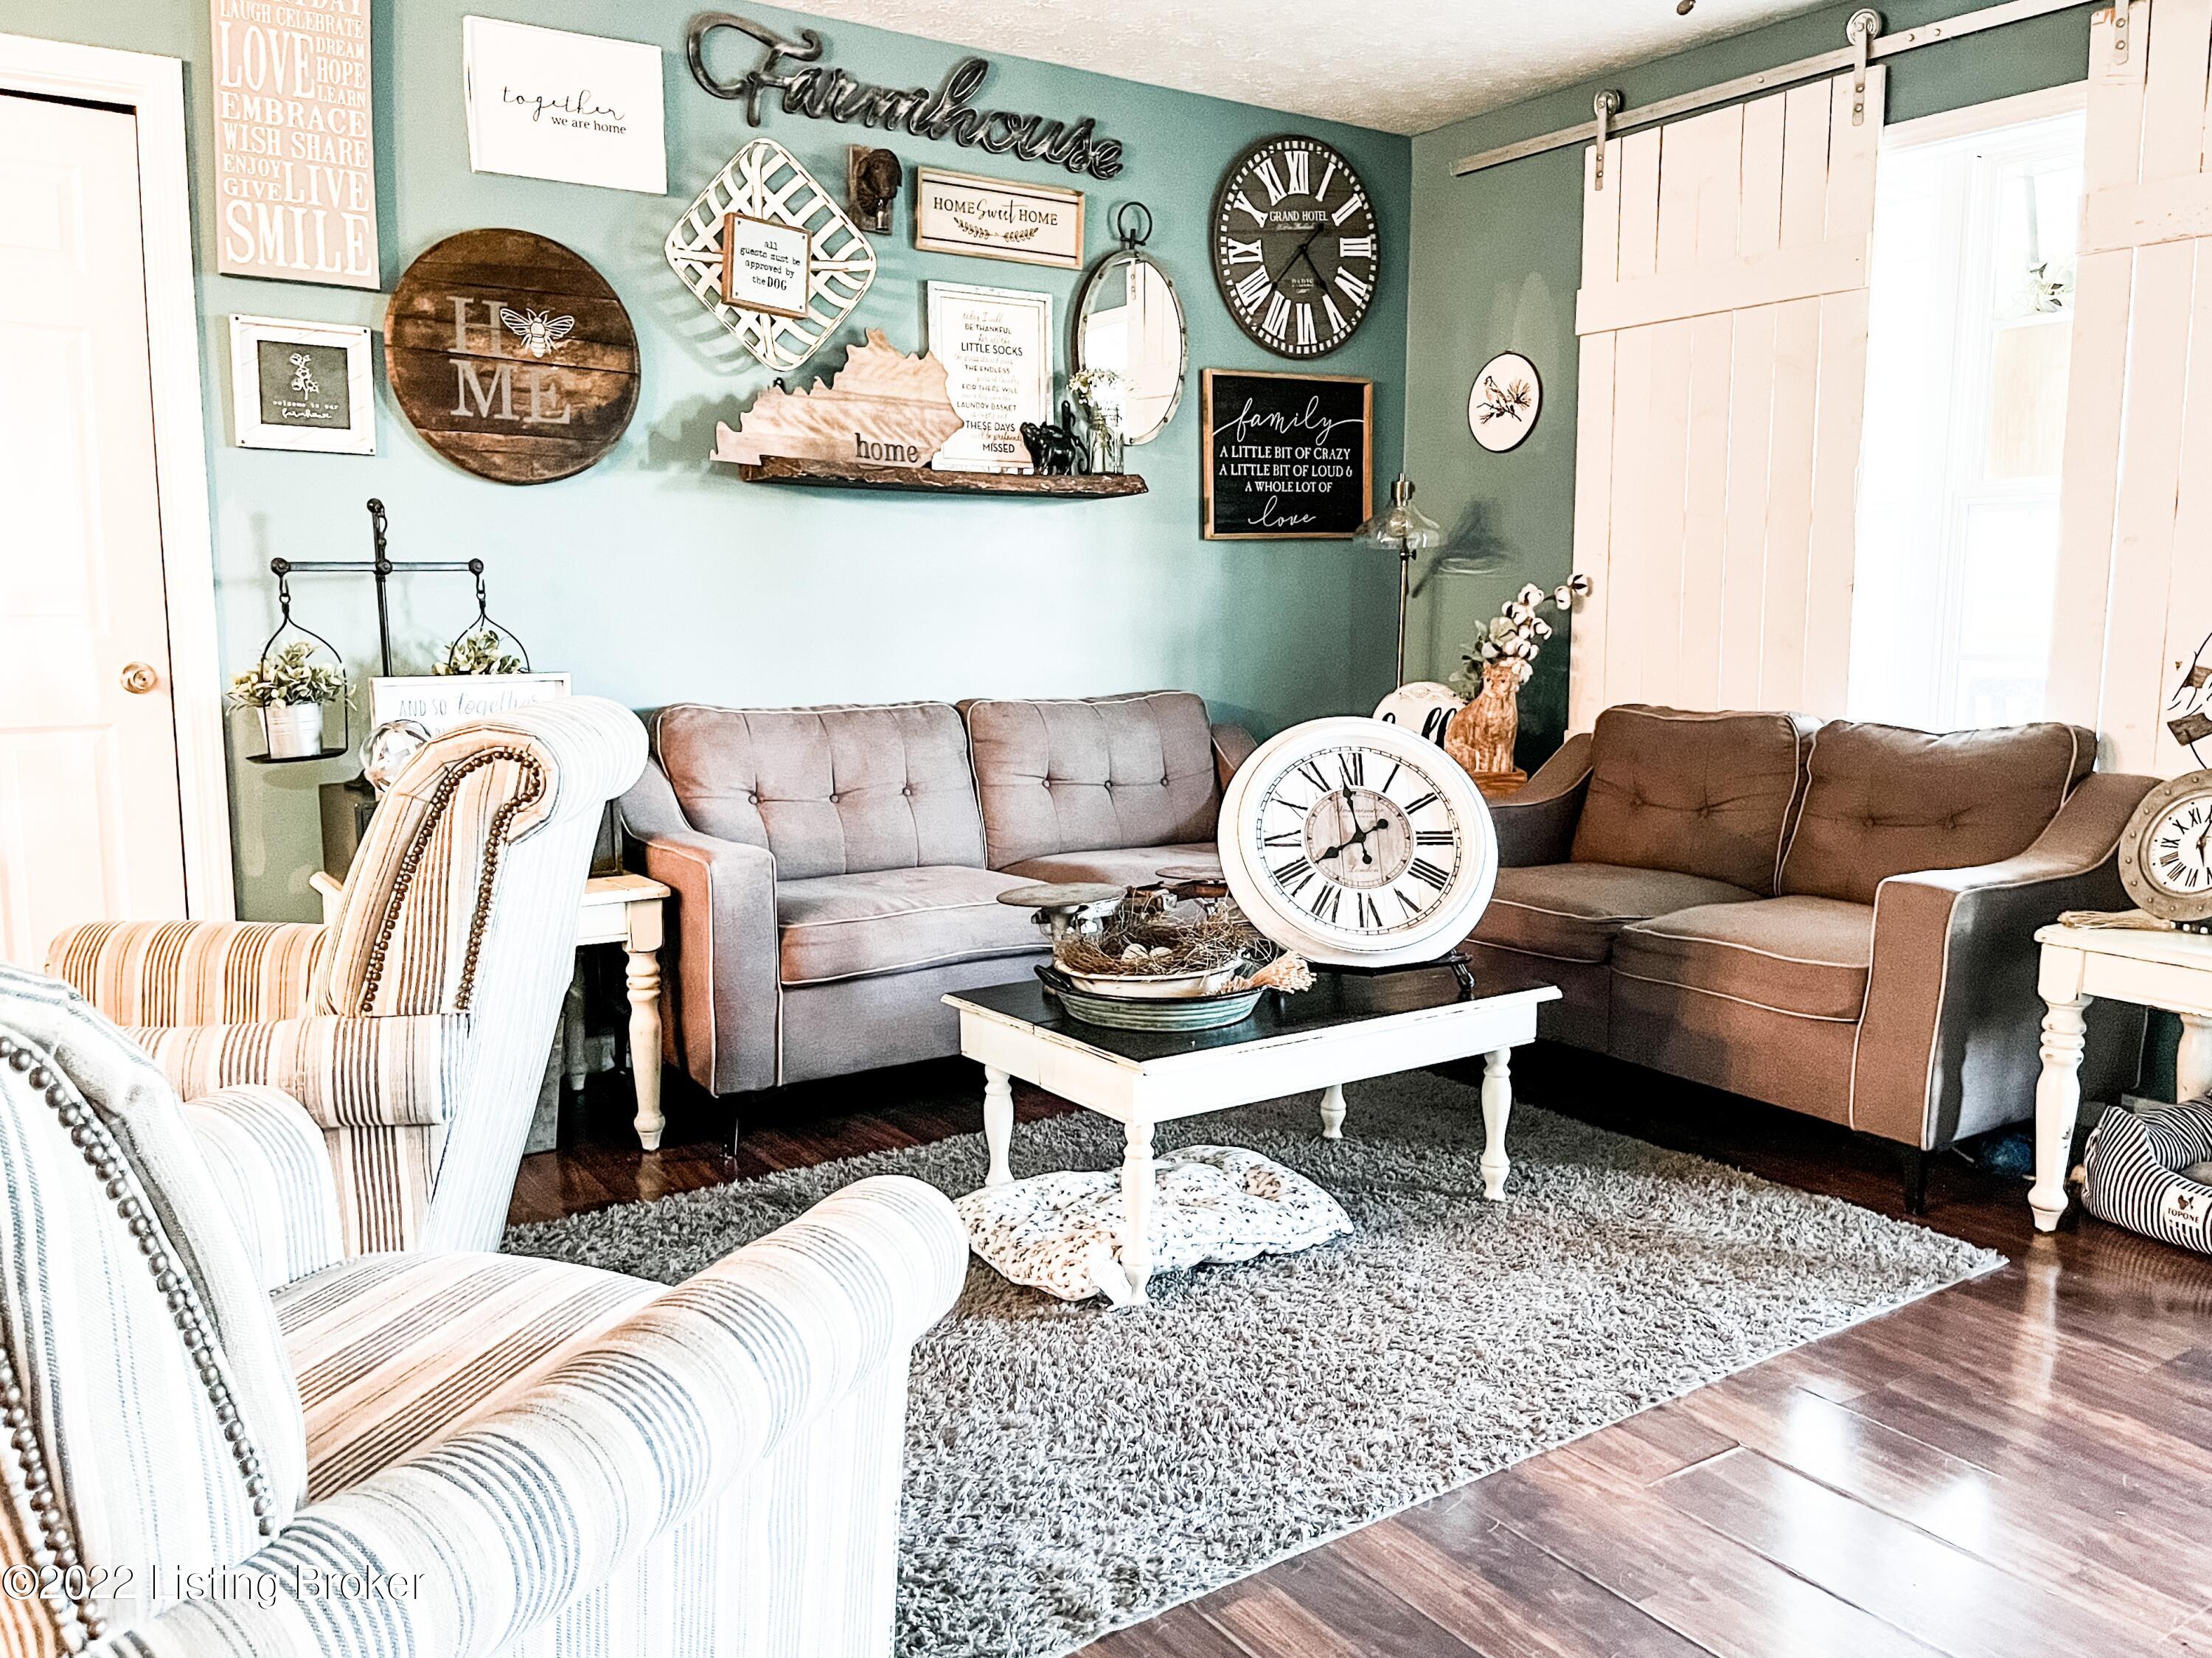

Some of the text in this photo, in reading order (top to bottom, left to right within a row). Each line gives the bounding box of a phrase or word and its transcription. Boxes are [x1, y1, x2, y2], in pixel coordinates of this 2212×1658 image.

[220, 0, 364, 39] LAUGH CELEBRATE
[316, 37, 365, 60] DREAM
[219, 21, 316, 99] LOVE
[316, 57, 366, 89] HOPE
[318, 85, 366, 108] LEARN
[501, 86, 626, 122] together
[686, 12, 1124, 179] Farmhouse
[220, 91, 367, 139] EMBRACE
[552, 116, 627, 134] we are home
[222, 122, 368, 168] WISH SHARE
[223, 153, 282, 178] ENJOY
[223, 178, 282, 202] GIVE
[282, 161, 369, 212] LIVE
[933, 197, 1057, 226] HOME Sweet HOME
[1270, 210, 1329, 221] GRAND HOTEL
[225, 200, 372, 276] SMILE
[764, 241, 778, 250] all
[740, 248, 800, 265] guests must be
[745, 260, 794, 278] approved by
[752, 276, 787, 290] the DOG
[976, 324, 1012, 334] THANKFUL
[961, 342, 1023, 356] LITTLE SOCKS
[980, 366, 1010, 374] ENDLESS
[957, 401, 1016, 411] LAUNDRY BASKET
[966, 420, 1015, 432] THESE DAYS
[1213, 396, 1364, 445] family
[855, 433, 919, 463] home
[983, 443, 1015, 453] MISSED
[1220, 445, 1351, 460] A LITTLE BIT OF CRAZY
[1219, 464, 1352, 478] A LITTLE BIT OF LOUD &
[1245, 481, 1333, 492] A WHOLE LOT OF
[1248, 495, 1316, 527] love
[399, 700, 426, 717] AND
[432, 700, 447, 716] SO
[2168, 1207, 2199, 1224] TOPONE
